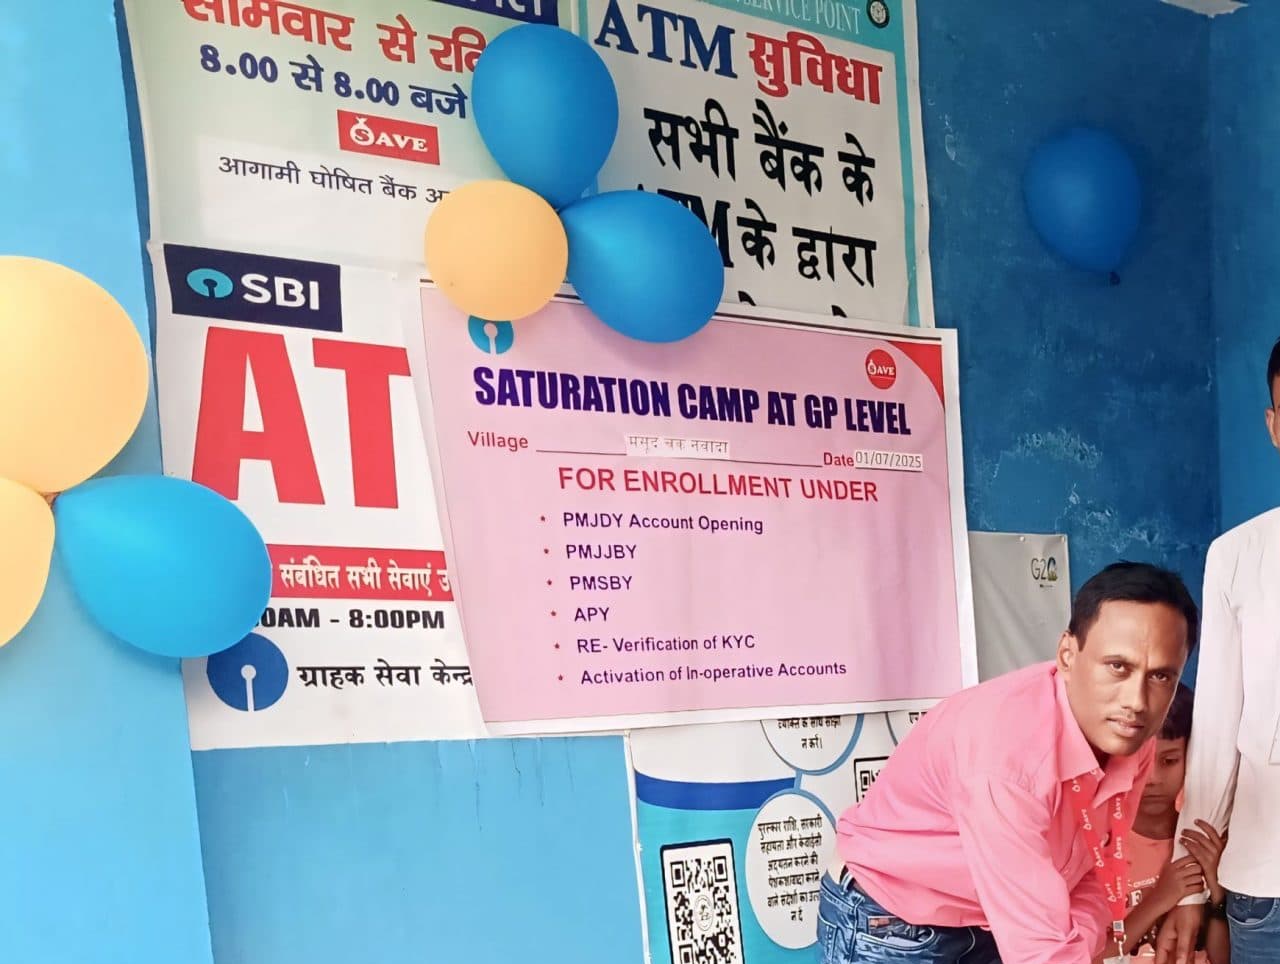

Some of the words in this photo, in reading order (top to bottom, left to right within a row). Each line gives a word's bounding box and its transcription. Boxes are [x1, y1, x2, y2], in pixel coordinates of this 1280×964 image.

[815, 0, 861, 34] POINT
[376, 14, 417, 64] से
[594, 0, 738, 79] ATM
[746, 31, 883, 104] सुविधा
[200, 44, 278, 83] 8.00
[289, 54, 324, 92] से
[334, 72, 400, 106] 8.00
[408, 83, 468, 119] बजे
[350, 117, 428, 152] SAVE
[643, 98, 739, 182] सभी
[752, 98, 824, 197] बैंक
[838, 132, 876, 207] के
[219, 156, 301, 185] आगामी
[308, 165, 373, 195] घोषित
[380, 174, 417, 201] बैंक
[736, 198, 777, 270] के
[792, 225, 877, 288] द्वारा
[242, 273, 319, 311] SBI
[867, 359, 895, 377] SAVE
[191, 326, 412, 509] AT
[473, 366, 672, 418] SATURATION
[677, 383, 760, 424] CAMP
[767, 391, 797, 427] AT
[804, 394, 838, 430] GP
[844, 397, 912, 436] LEVEL
[467, 431, 529, 452] Village
[822, 452, 855, 468] Date
[855, 451, 922, 469] 01/07/2025
[558, 466, 616, 491] FOR
[623, 469, 793, 498] ENROLLMENT
[800, 479, 879, 502] UNDER
[563, 512, 624, 528] PMJDY
[629, 513, 694, 530] Account
[698, 515, 764, 535] Opening
[565, 544, 638, 560] PMJJBY
[279, 555, 341, 588] संबंधित
[346, 556, 382, 589] सभी
[386, 559, 433, 597] सेवाएं
[569, 575, 634, 591] PMSBY
[349, 608, 445, 629] 8:00PM
[574, 607, 611, 623] APY
[576, 638, 609, 654] RE-
[612, 636, 699, 652] Verification
[703, 634, 718, 650] of
[721, 634, 756, 650] KYC
[296, 665, 365, 690] ग्राहक
[373, 658, 421, 687] सेवा
[580, 667, 665, 685] Activation
[668, 665, 683, 682] of
[686, 664, 774, 683] In-operative
[777, 661, 848, 677] Accounts
